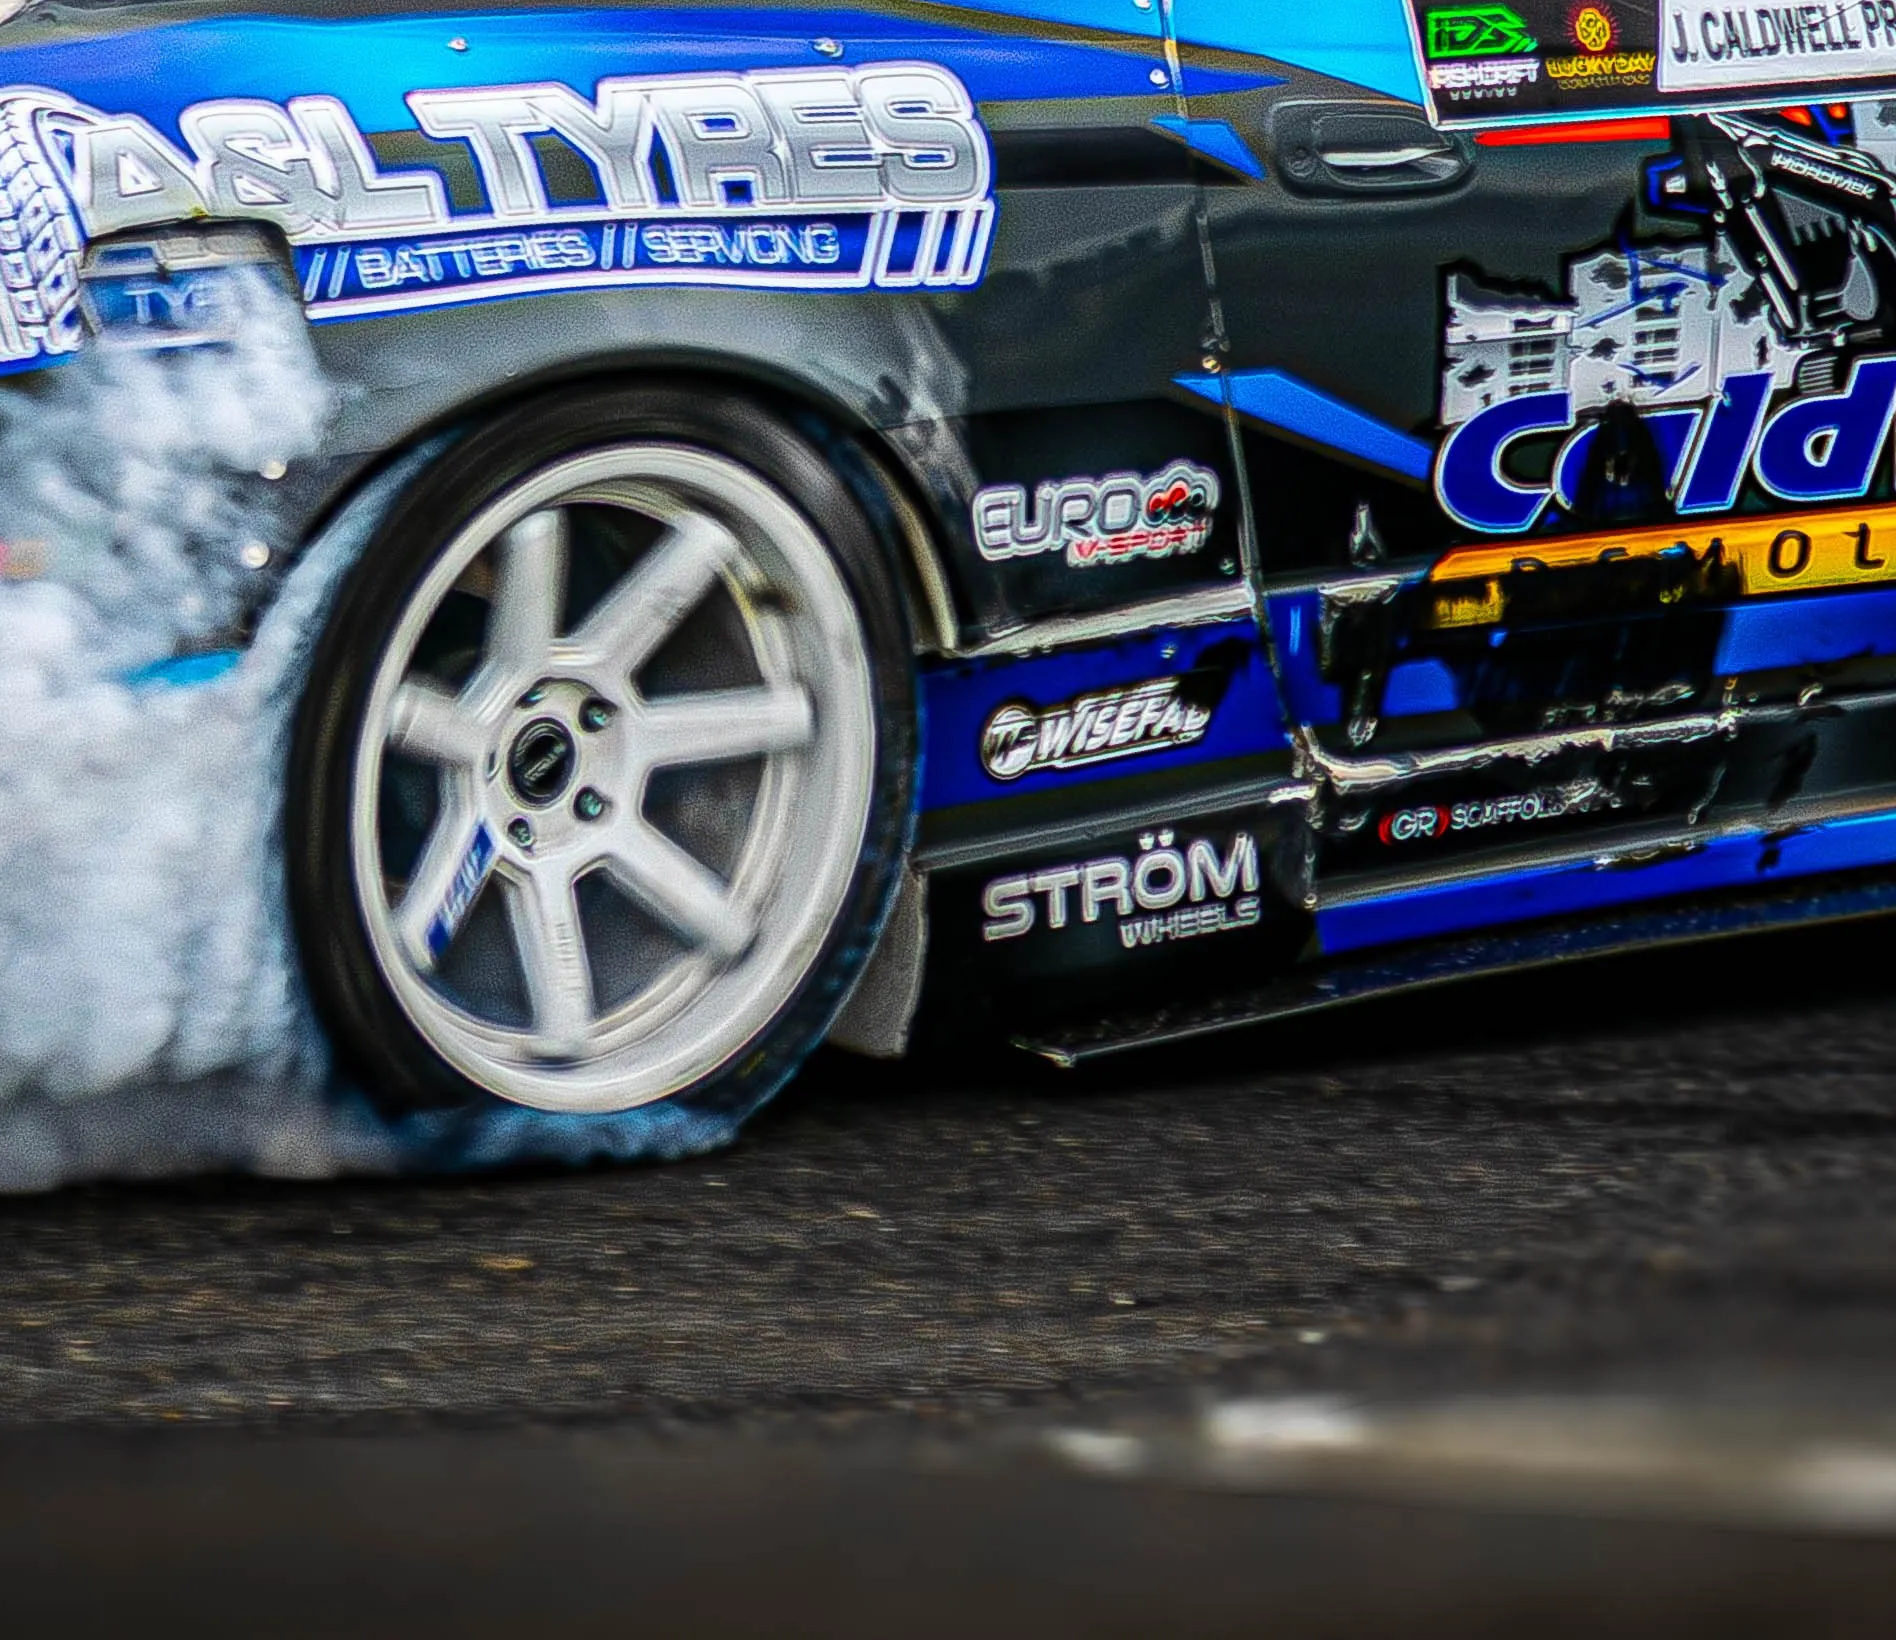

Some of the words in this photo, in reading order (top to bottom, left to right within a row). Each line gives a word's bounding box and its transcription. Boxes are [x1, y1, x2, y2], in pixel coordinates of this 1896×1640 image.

[1672, 9, 1699, 63] J.
[1704, 0, 1862, 61] CALDWELL
[404, 60, 982, 222] TYRES
[354, 228, 598, 290] BATTERIES
[974, 475, 1144, 560] EURO
[981, 827, 1261, 942] STRÖM
[1117, 895, 1262, 949] WHEELS
